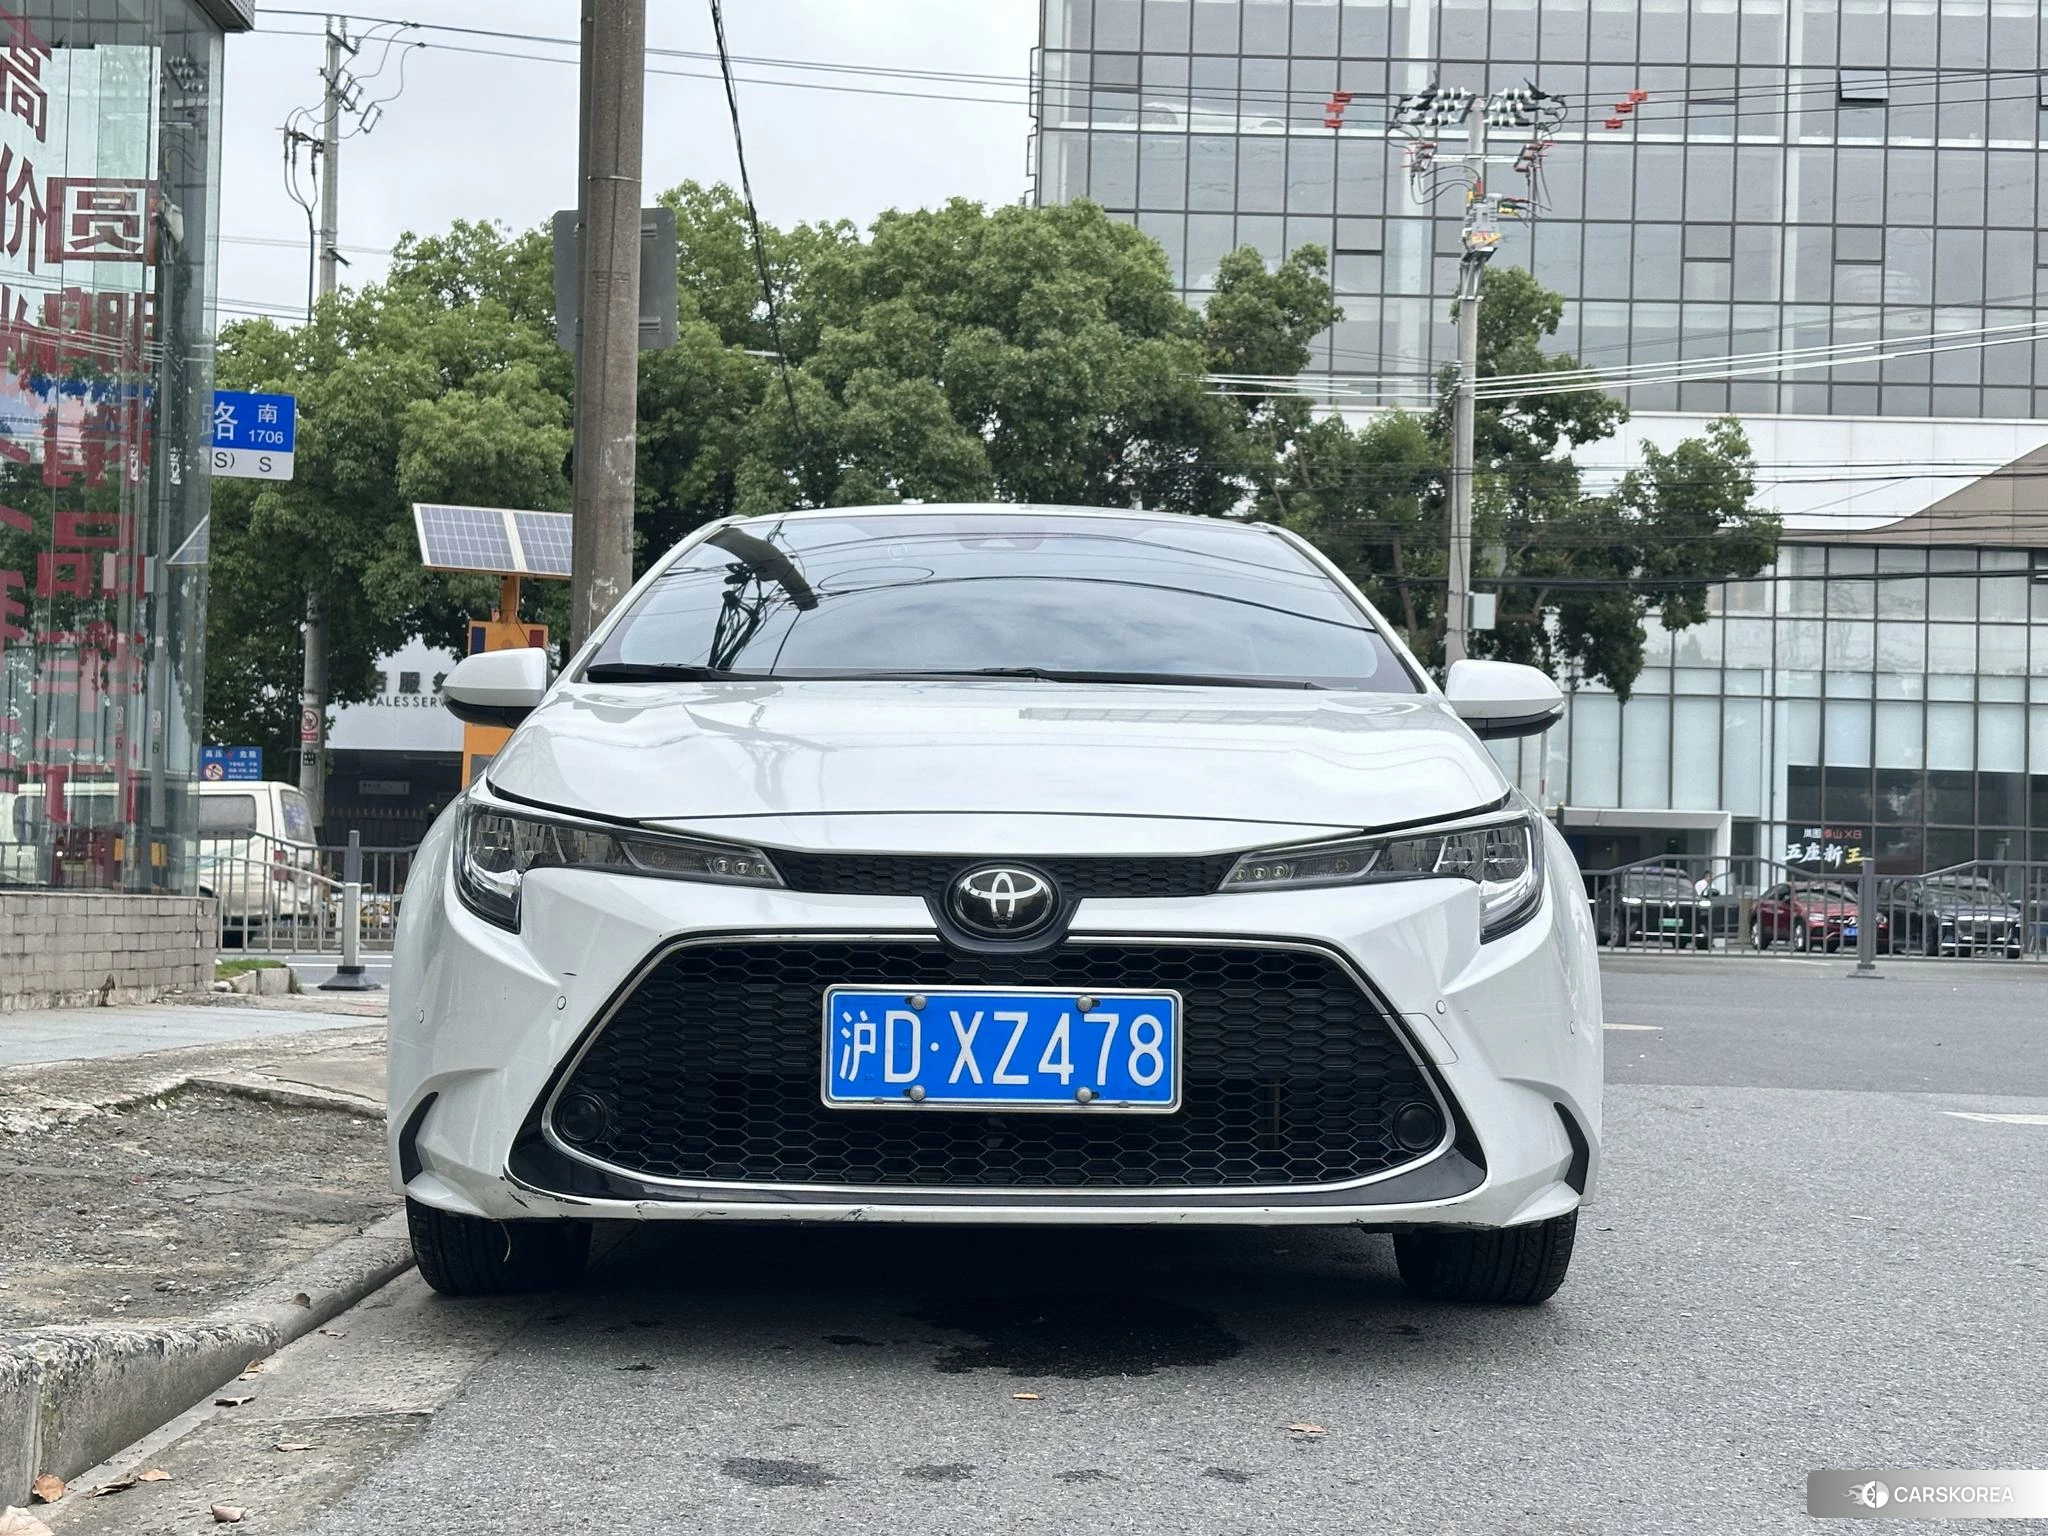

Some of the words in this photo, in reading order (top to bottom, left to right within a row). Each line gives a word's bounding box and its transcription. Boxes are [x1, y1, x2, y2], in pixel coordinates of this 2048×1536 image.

[257, 403, 278, 424] 南
[248, 429, 284, 444] 1706
[259, 456, 272, 472] S
